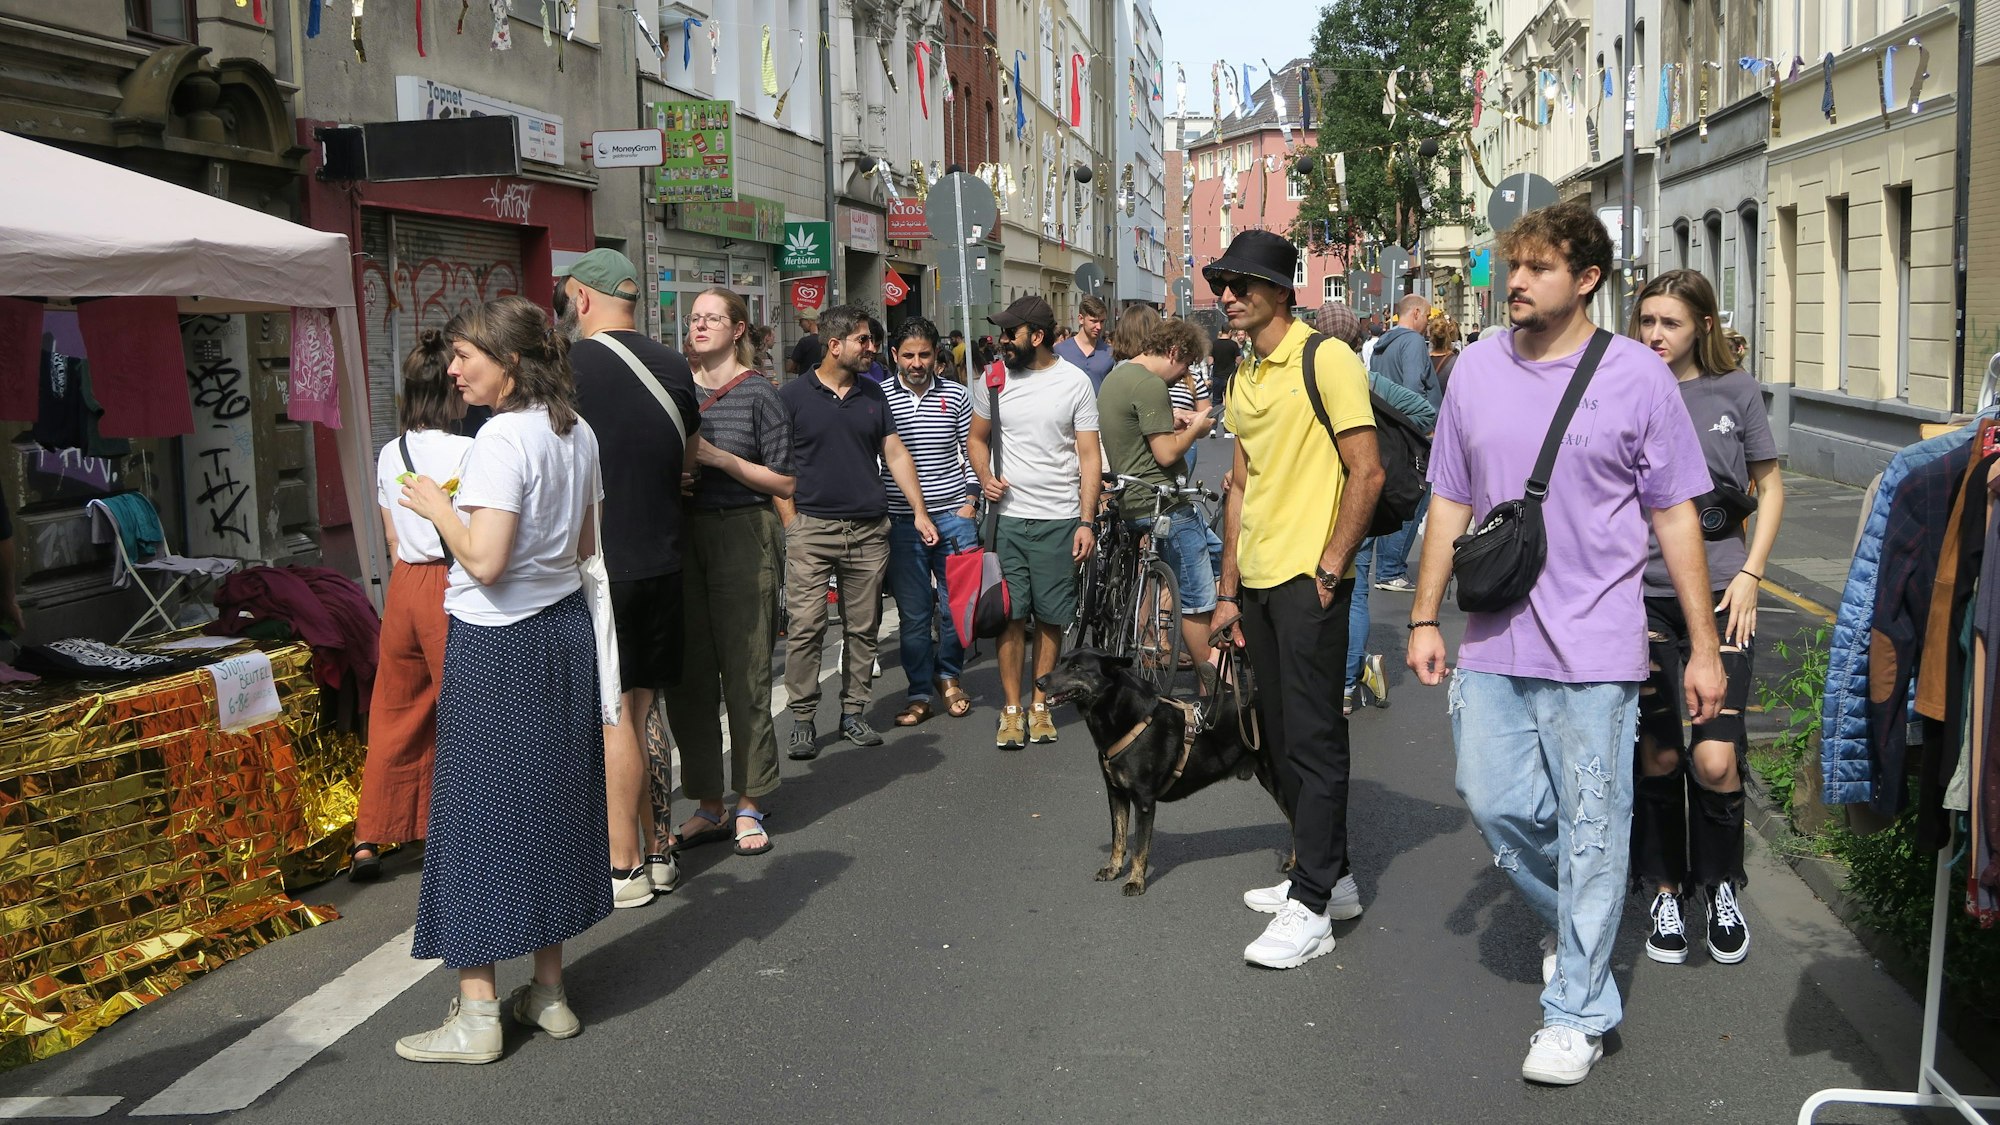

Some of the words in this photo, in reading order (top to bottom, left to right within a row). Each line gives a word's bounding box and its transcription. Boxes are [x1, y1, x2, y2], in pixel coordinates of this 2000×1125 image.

[426, 80, 463, 106] Topnet
[612, 145, 657, 153] MoneyGram
[889, 202, 924, 215] Kios
[784, 256, 820, 265] Herbistan
[239, 666, 271, 690] BEUTEL
